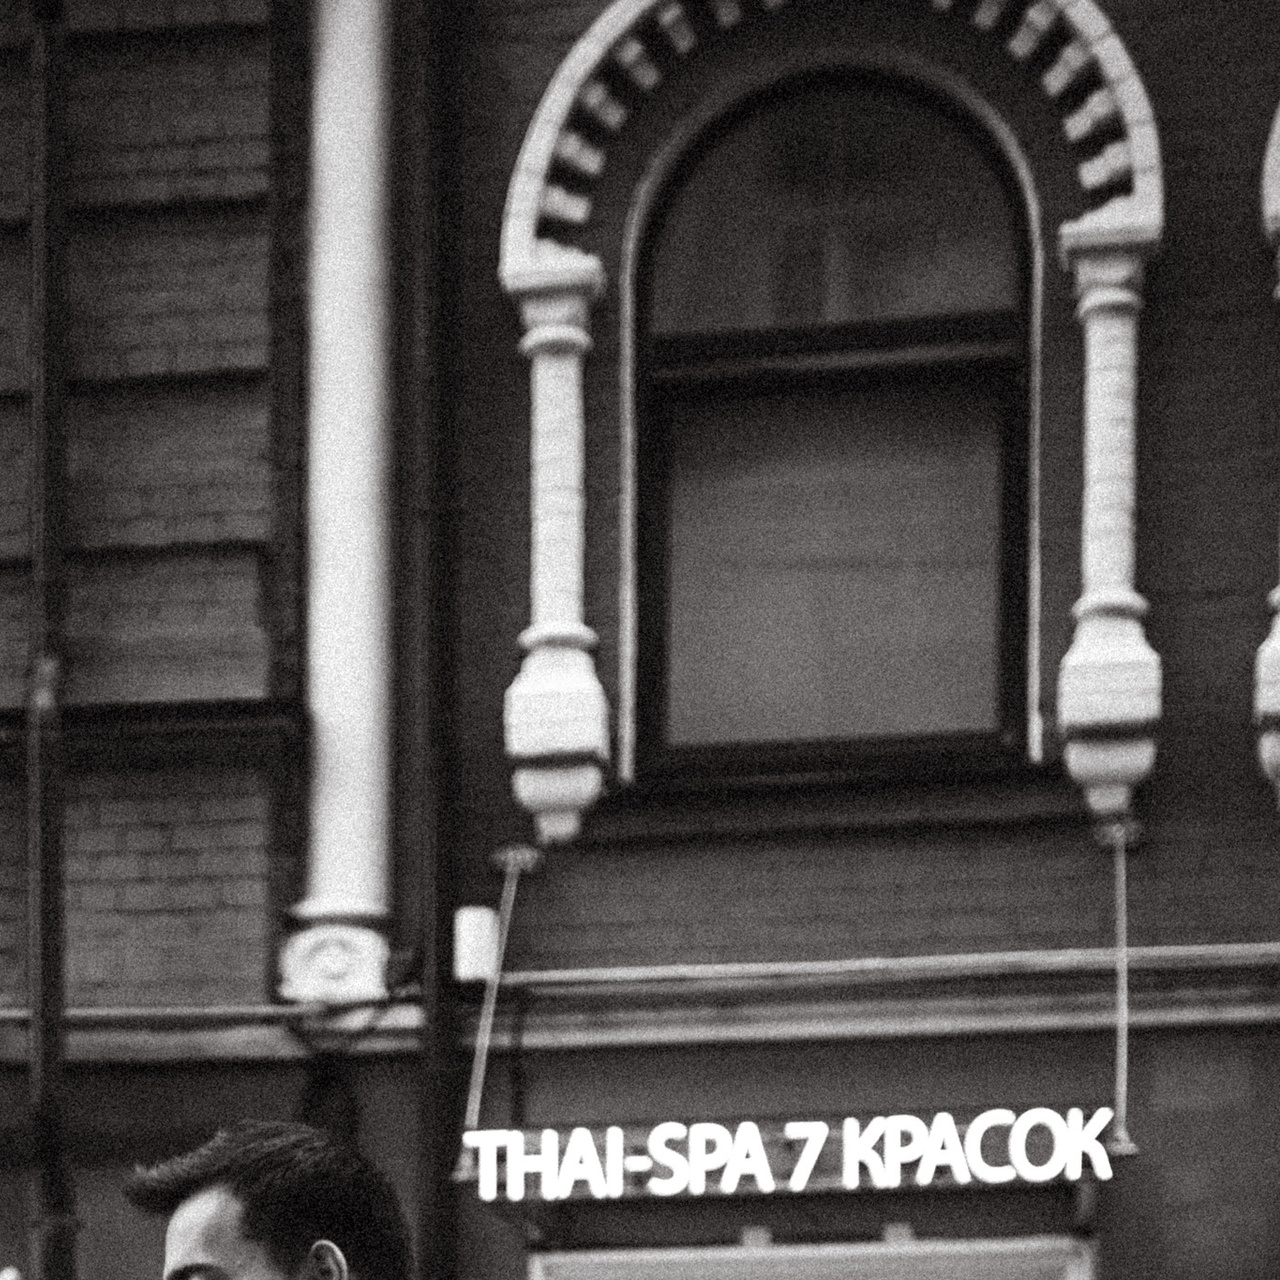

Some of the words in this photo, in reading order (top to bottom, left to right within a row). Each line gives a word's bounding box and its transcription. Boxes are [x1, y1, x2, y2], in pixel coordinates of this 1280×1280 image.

[462, 1121, 777, 1201] THAI-SPA
[784, 1121, 830, 1192] 7
[841, 1107, 1114, 1190] КРАСОК
